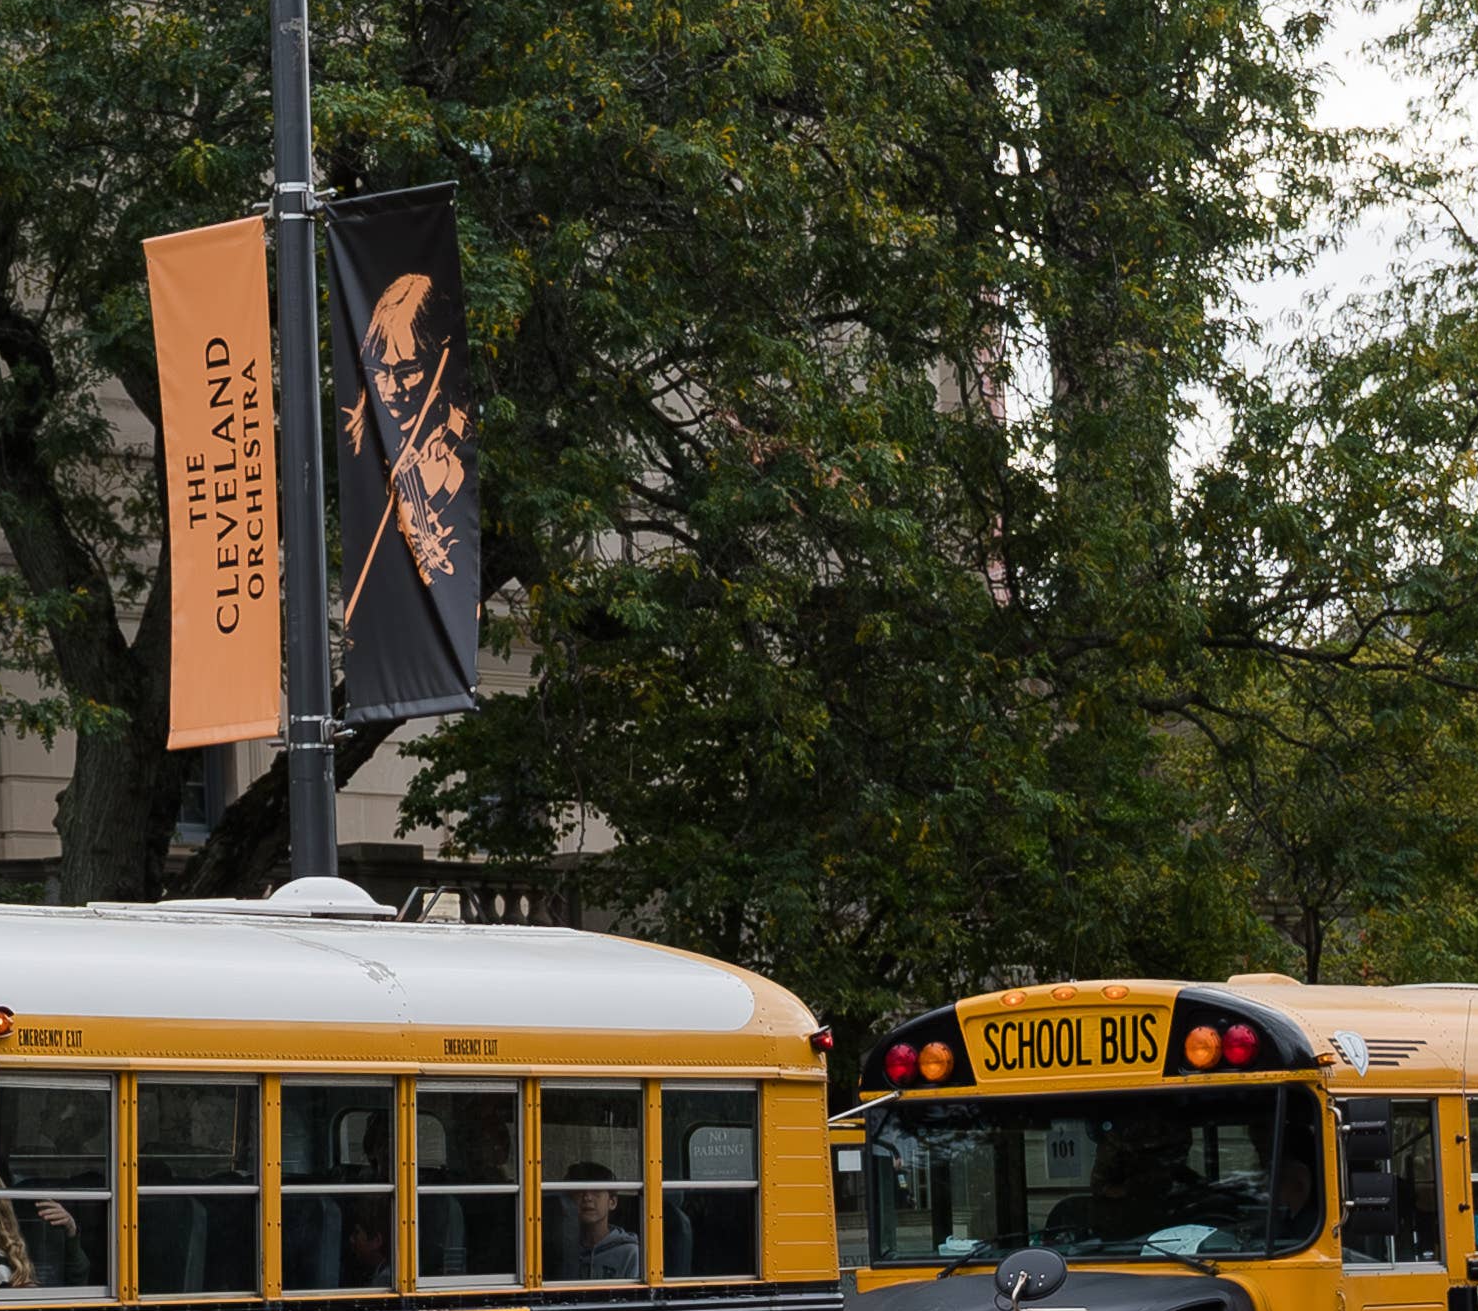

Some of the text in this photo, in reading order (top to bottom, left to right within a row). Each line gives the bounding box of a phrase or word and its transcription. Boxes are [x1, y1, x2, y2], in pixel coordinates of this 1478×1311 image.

[186, 453, 208, 529] THE
[205, 337, 241, 634] CLEVELAND
[241, 357, 265, 600] ORCHESTRA
[18, 1028, 83, 1048] EMERGENCY EXIT
[444, 1038, 498, 1056] EMERGENCY EXIT
[983, 1013, 1159, 1072] SCHOOL BUS
[693, 1143, 745, 1158] PARKING
[708, 1129, 728, 1143] NO
